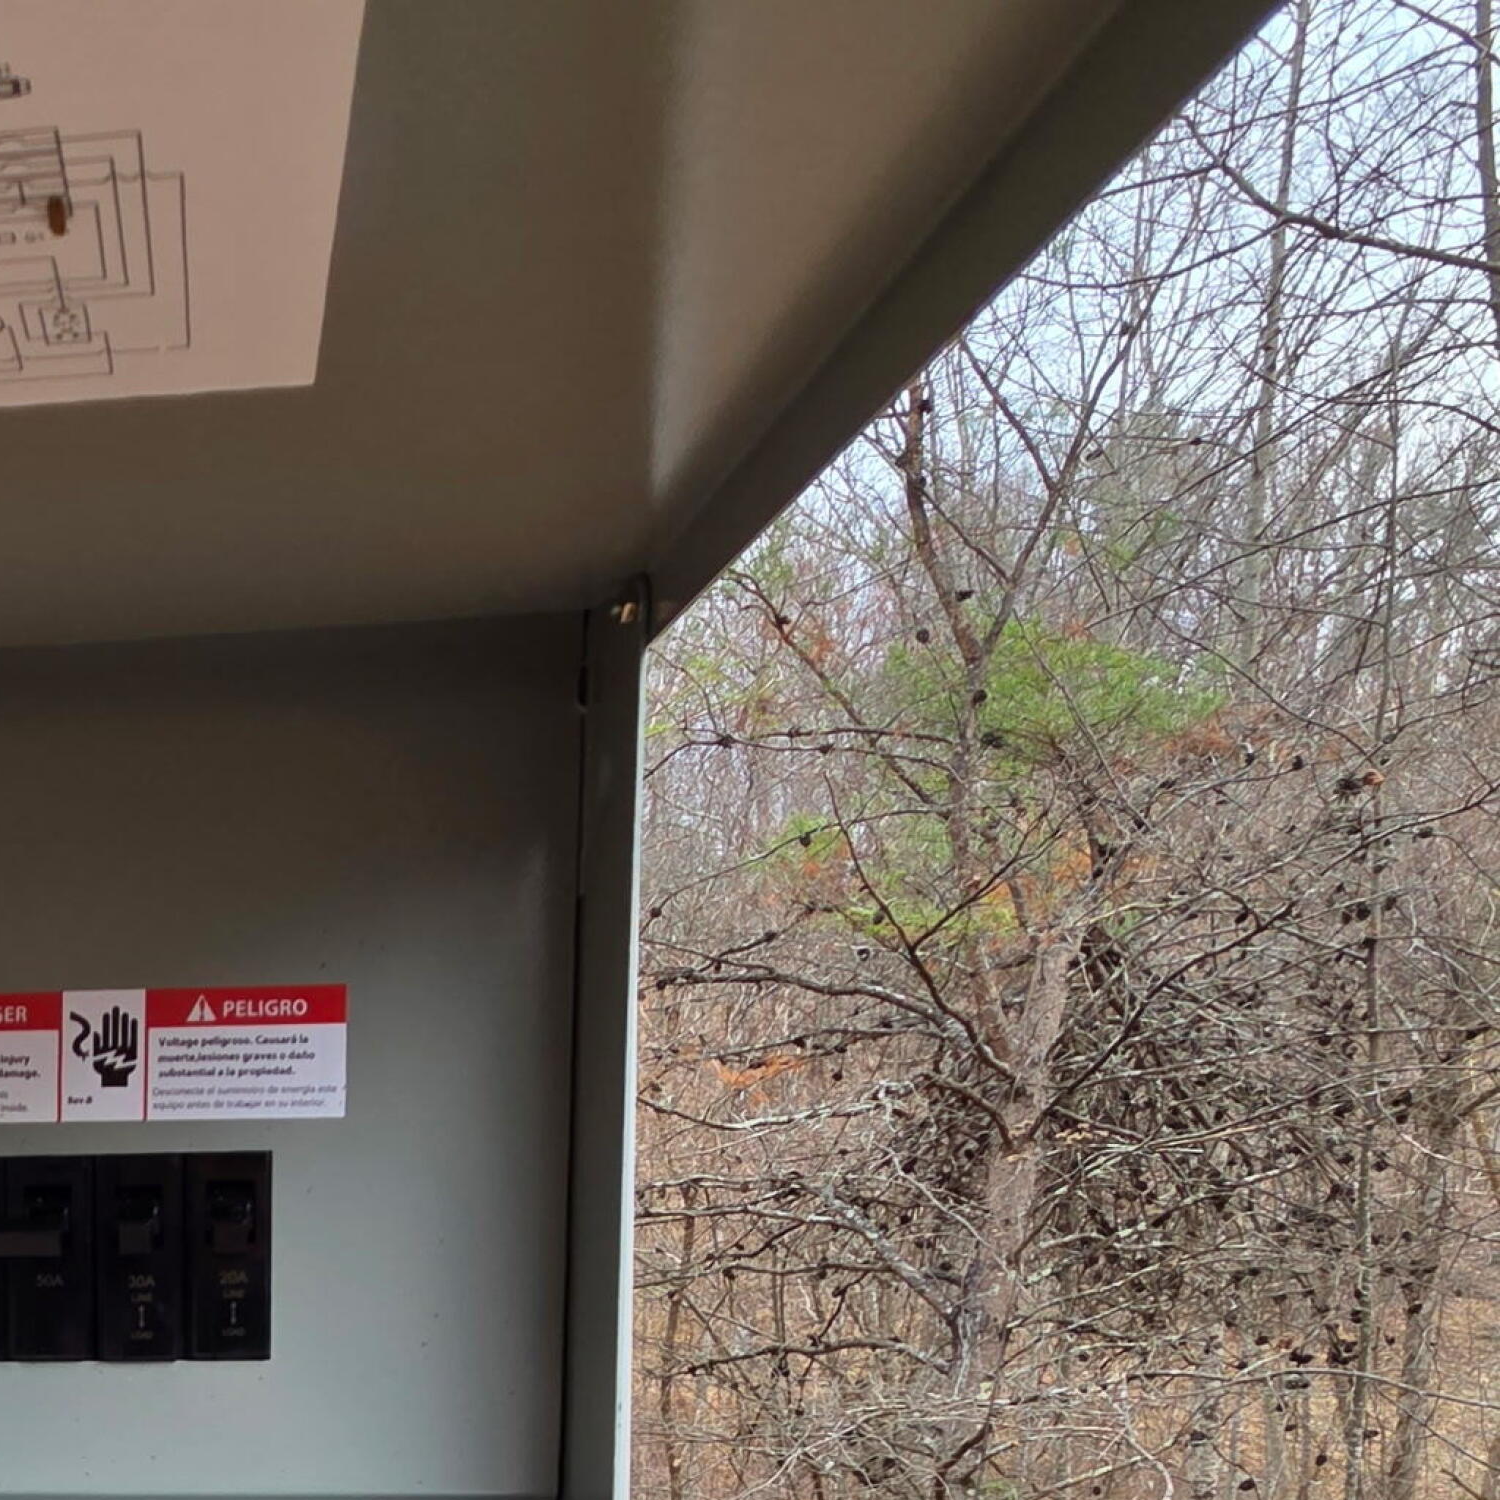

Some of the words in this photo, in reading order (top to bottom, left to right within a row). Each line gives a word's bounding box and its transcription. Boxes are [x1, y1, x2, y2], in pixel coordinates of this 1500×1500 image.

[223, 998, 308, 1018] PELIGRO
[158, 1037, 199, 1048] Voltage
[201, 1035, 252, 1047] peligroso.
[255, 1033, 297, 1044] Causará
[299, 1033, 309, 1044] la
[0, 1055, 30, 1066] injury
[242, 1052, 277, 1063] graves
[288, 1050, 315, 1060] daño
[226, 1067, 235, 1076] la
[267, 1085, 279, 1094] de
[187, 1101, 211, 1109] antes
[213, 1100, 224, 1108] de
[36, 1273, 64, 1288] 50A
[129, 1273, 155, 1288] 30A
[219, 1271, 248, 1285] 20A
